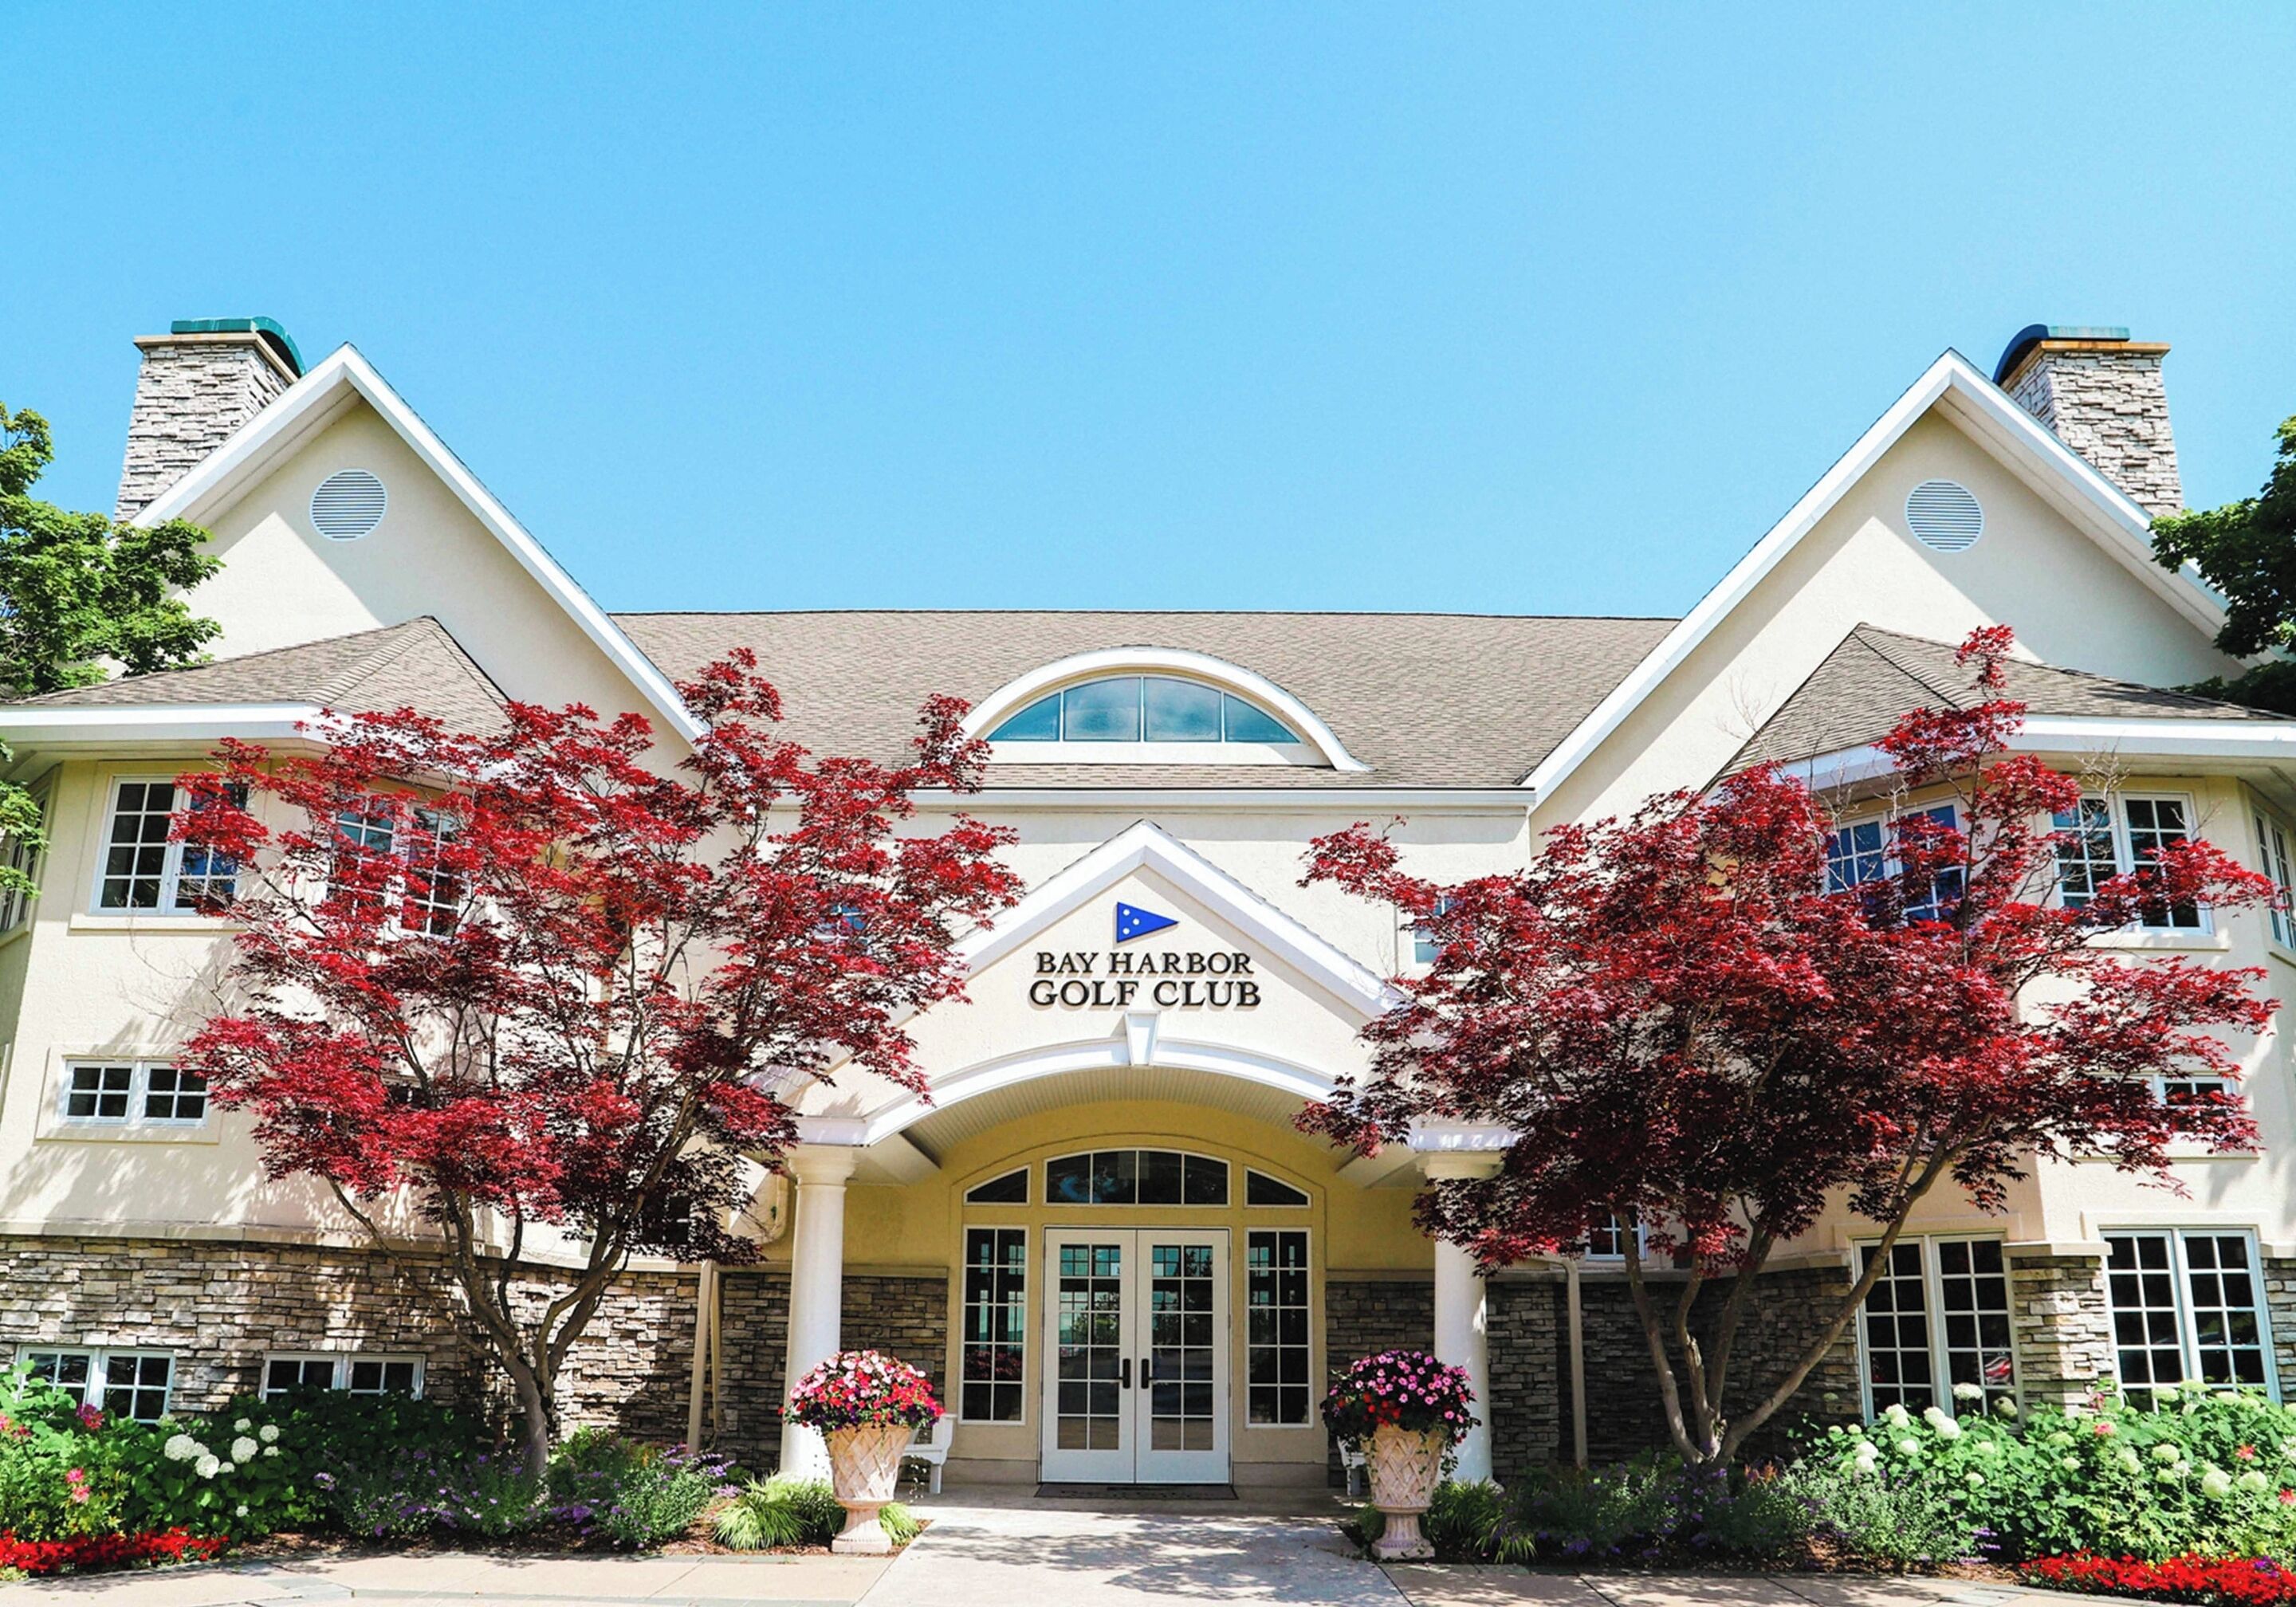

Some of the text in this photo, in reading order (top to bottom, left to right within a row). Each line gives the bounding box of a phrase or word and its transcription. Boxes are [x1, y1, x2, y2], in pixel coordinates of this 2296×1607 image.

[1036, 952, 1255, 975] BAY HARBOR
[1029, 980, 1262, 1008] GOLF CLUB
